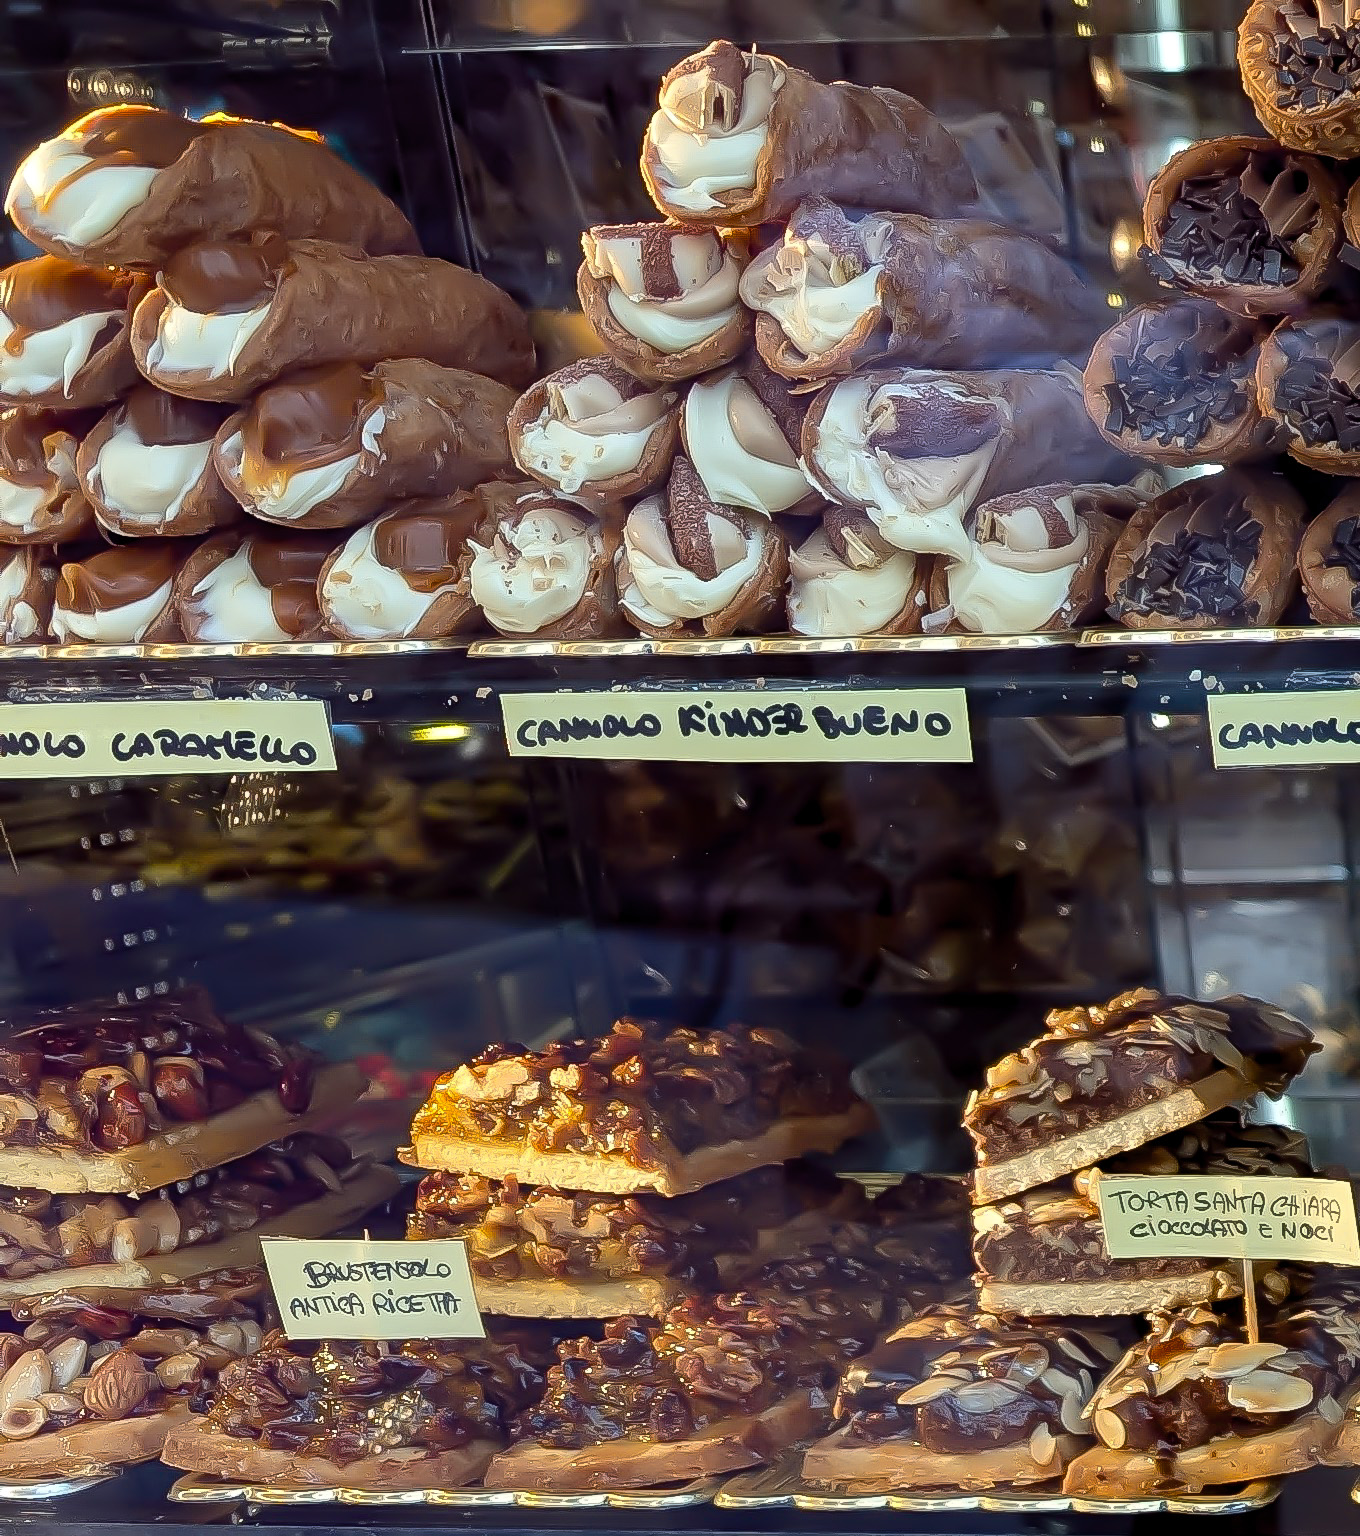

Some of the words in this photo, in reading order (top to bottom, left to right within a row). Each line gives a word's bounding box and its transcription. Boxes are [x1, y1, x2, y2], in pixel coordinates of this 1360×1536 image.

[516, 712, 662, 748] CANNOLO
[811, 705, 952, 741] BUENO
[112, 728, 318, 766] CARAMELLO
[1107, 1189, 1189, 1215] TORTA
[1193, 1188, 1266, 1216] SANTA
[1258, 1223, 1273, 1239] E
